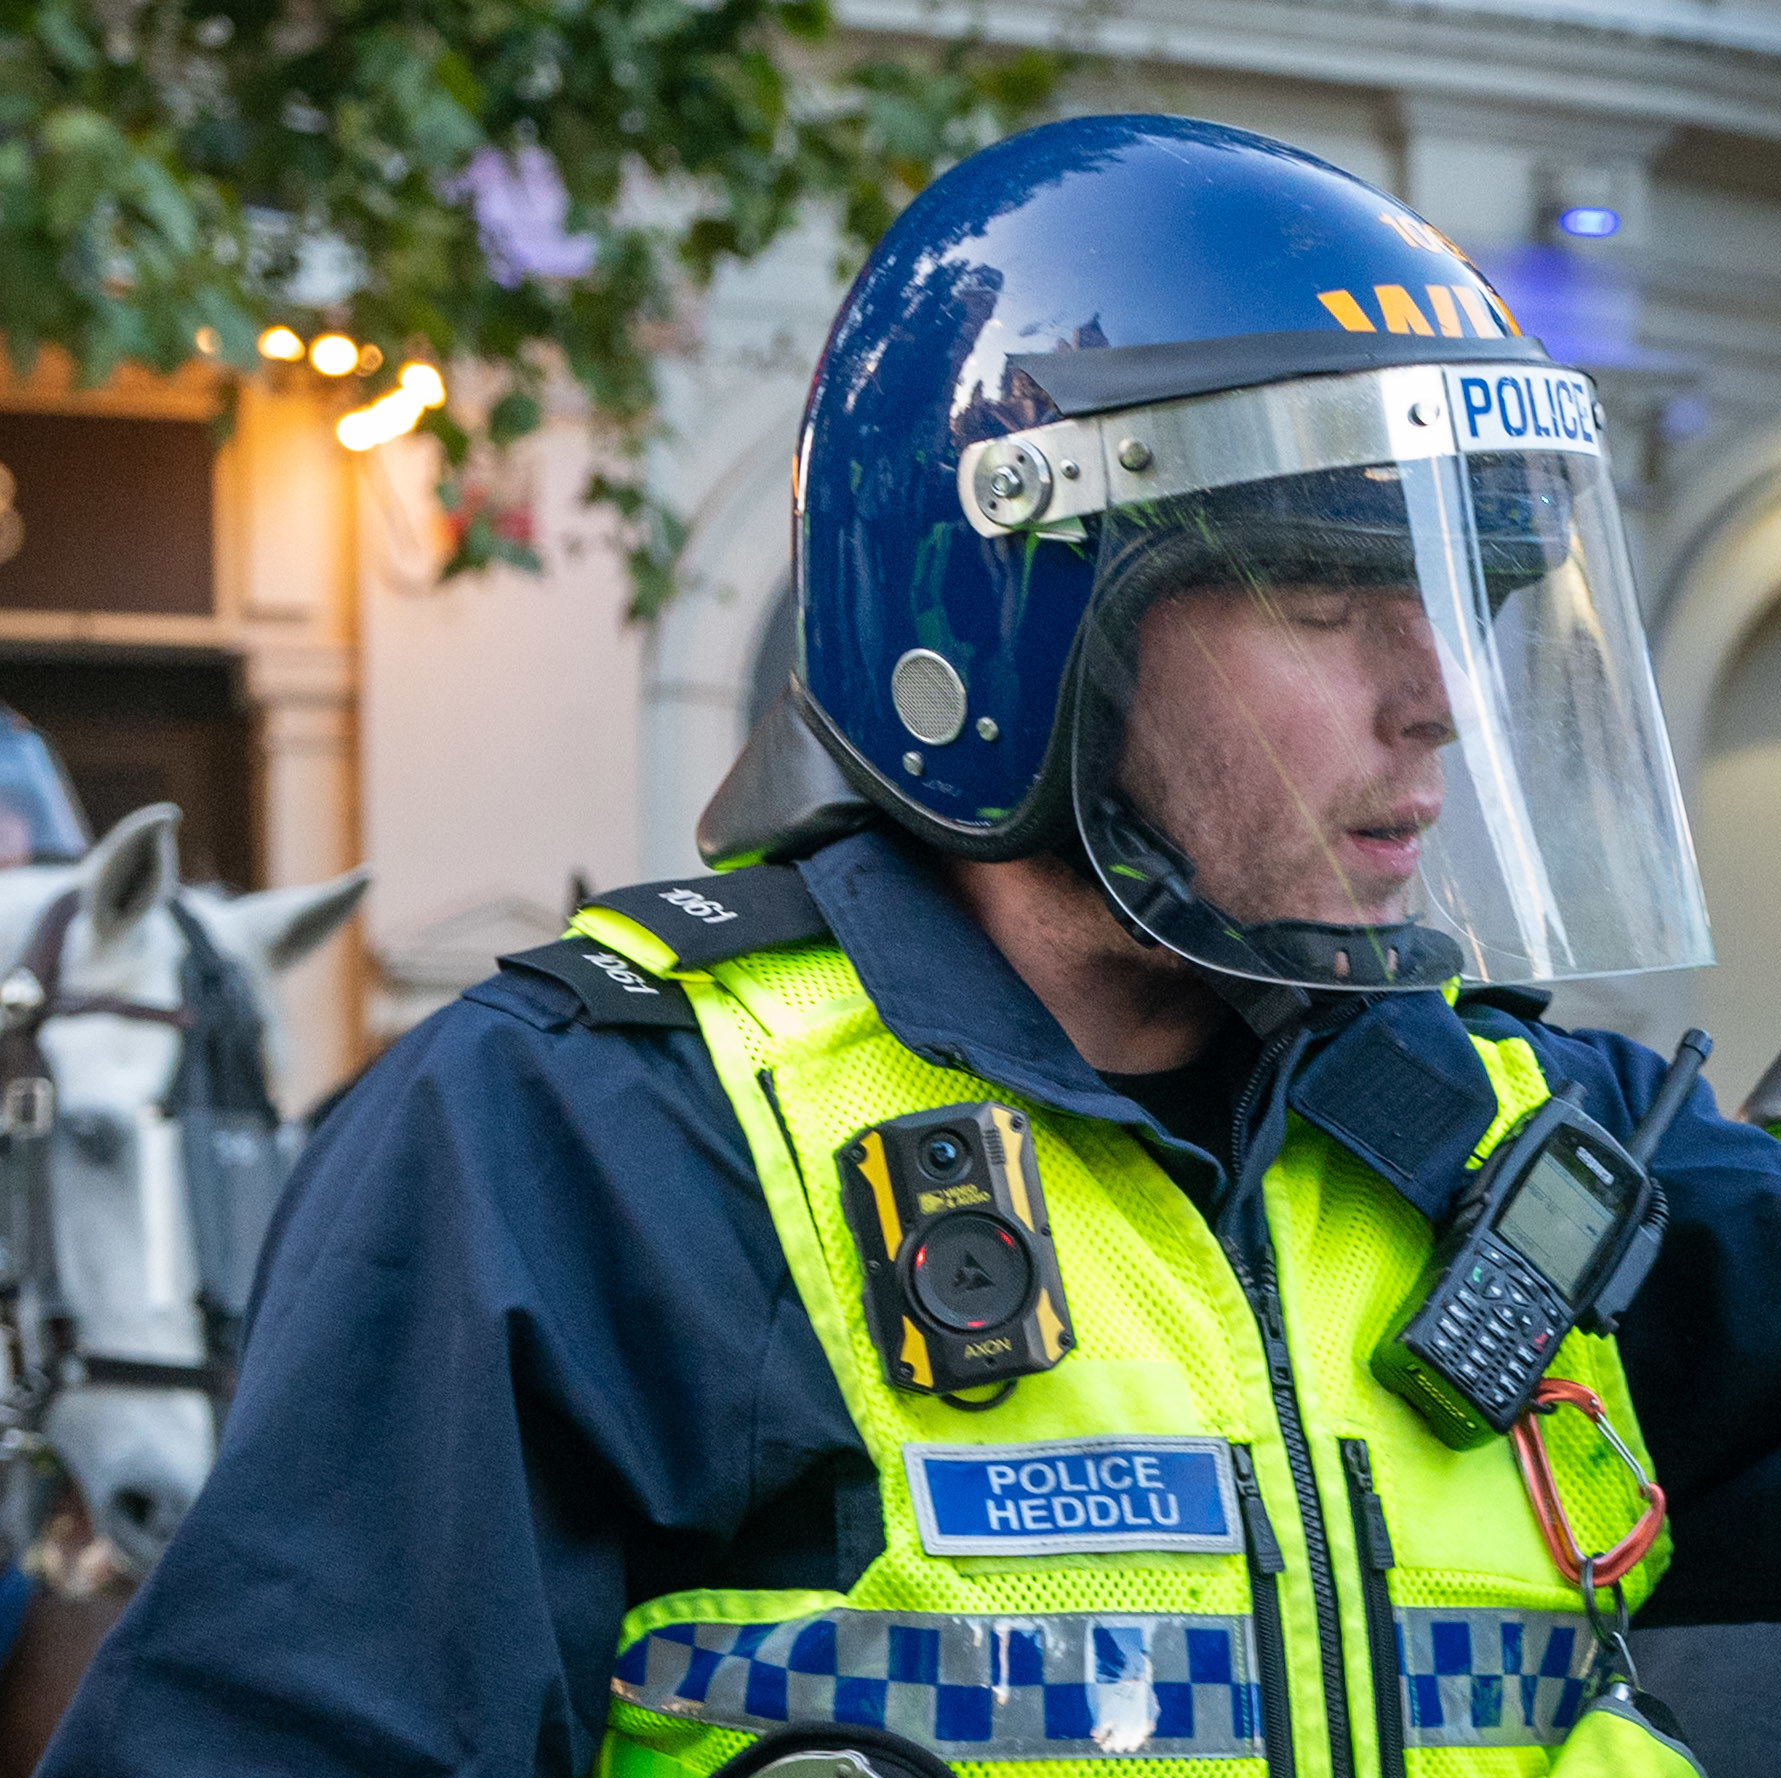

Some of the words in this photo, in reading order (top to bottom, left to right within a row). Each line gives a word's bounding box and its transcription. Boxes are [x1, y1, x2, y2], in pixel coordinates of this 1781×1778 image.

[1460, 376, 1595, 444] POLICE
[963, 1337, 1013, 1360] AXON
[985, 1456, 1166, 1495] POLICE
[984, 1493, 1181, 1531] HEDDLU
